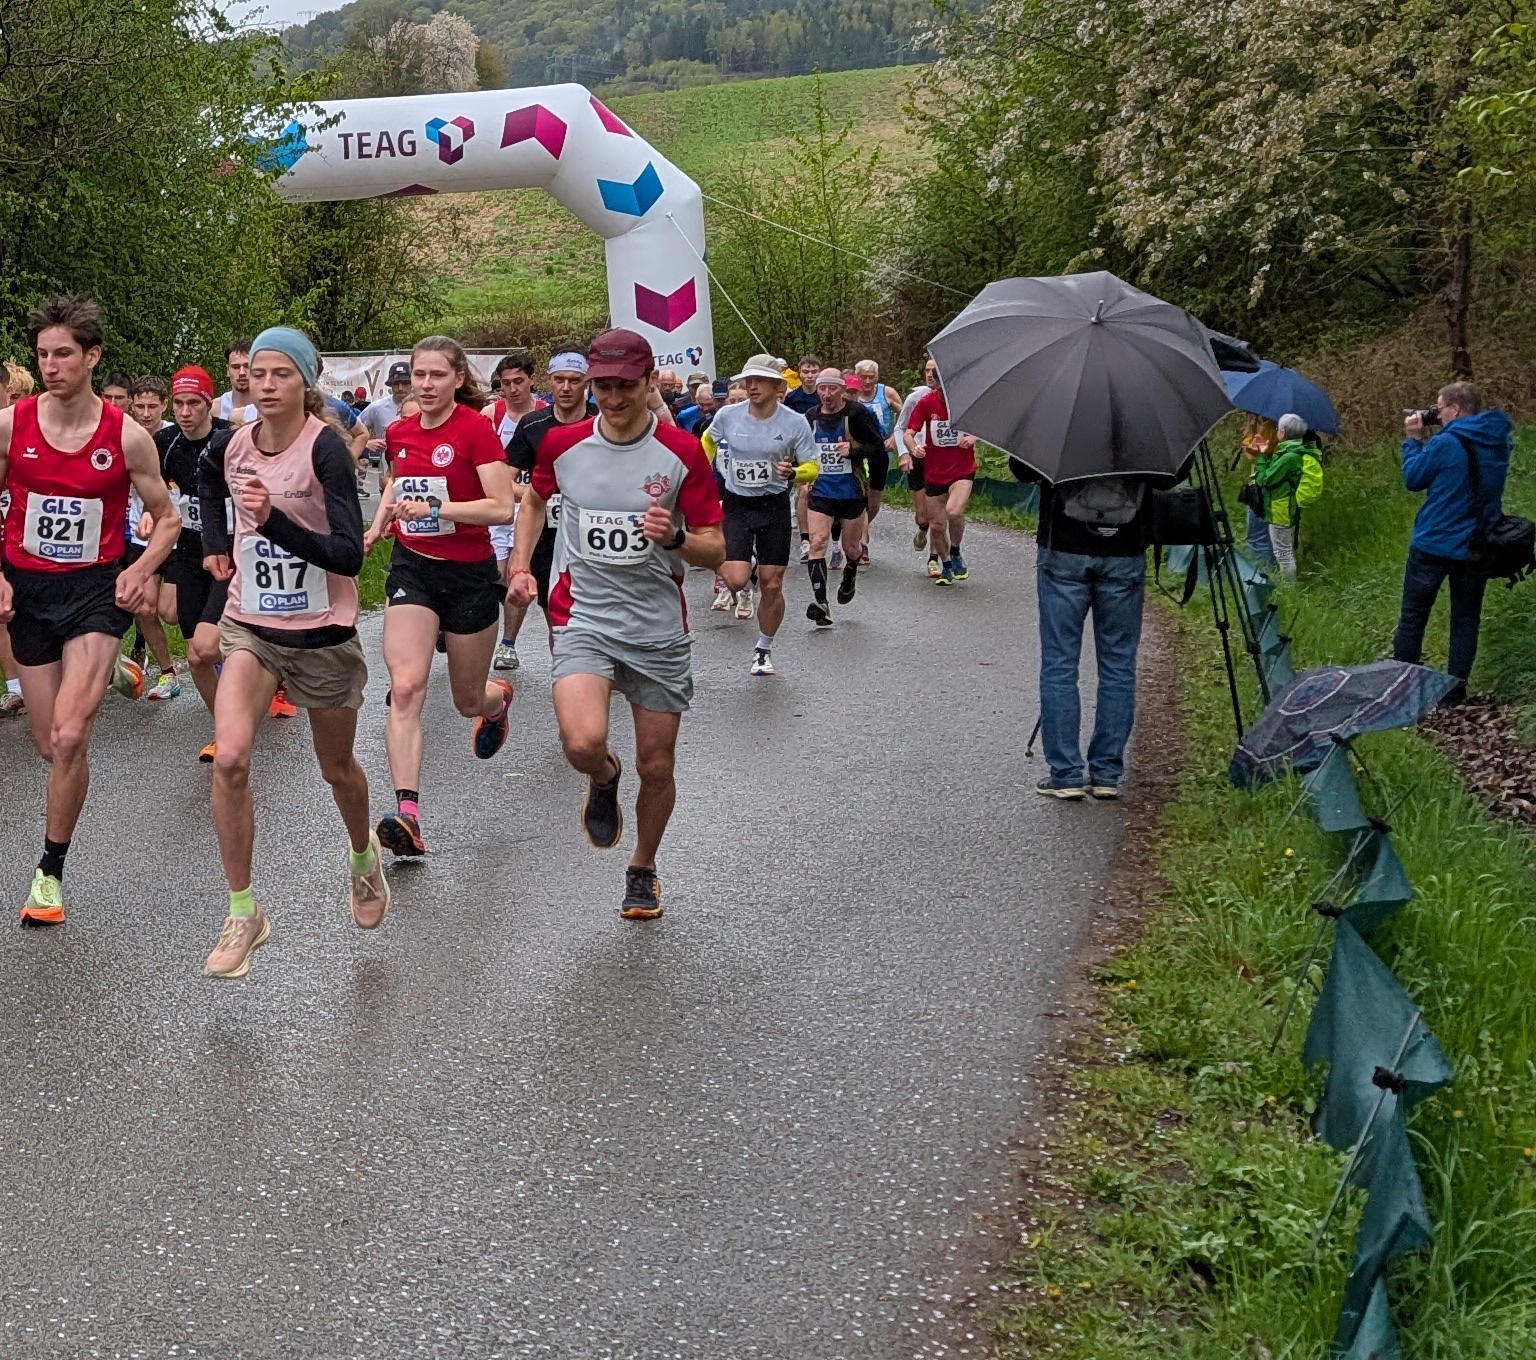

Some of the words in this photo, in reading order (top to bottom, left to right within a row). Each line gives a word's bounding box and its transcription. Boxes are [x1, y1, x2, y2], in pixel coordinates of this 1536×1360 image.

[337, 129, 417, 160] TEAG
[820, 452, 844, 465] 852
[736, 468, 770, 481] 614
[418, 521, 438, 530] PLAN
[588, 514, 624, 526] TEAG
[37, 515, 86, 542] 821
[587, 528, 649, 552] 603
[56, 546, 82, 555] PLAN
[255, 560, 308, 591] 817
[277, 594, 307, 606] PLAN
